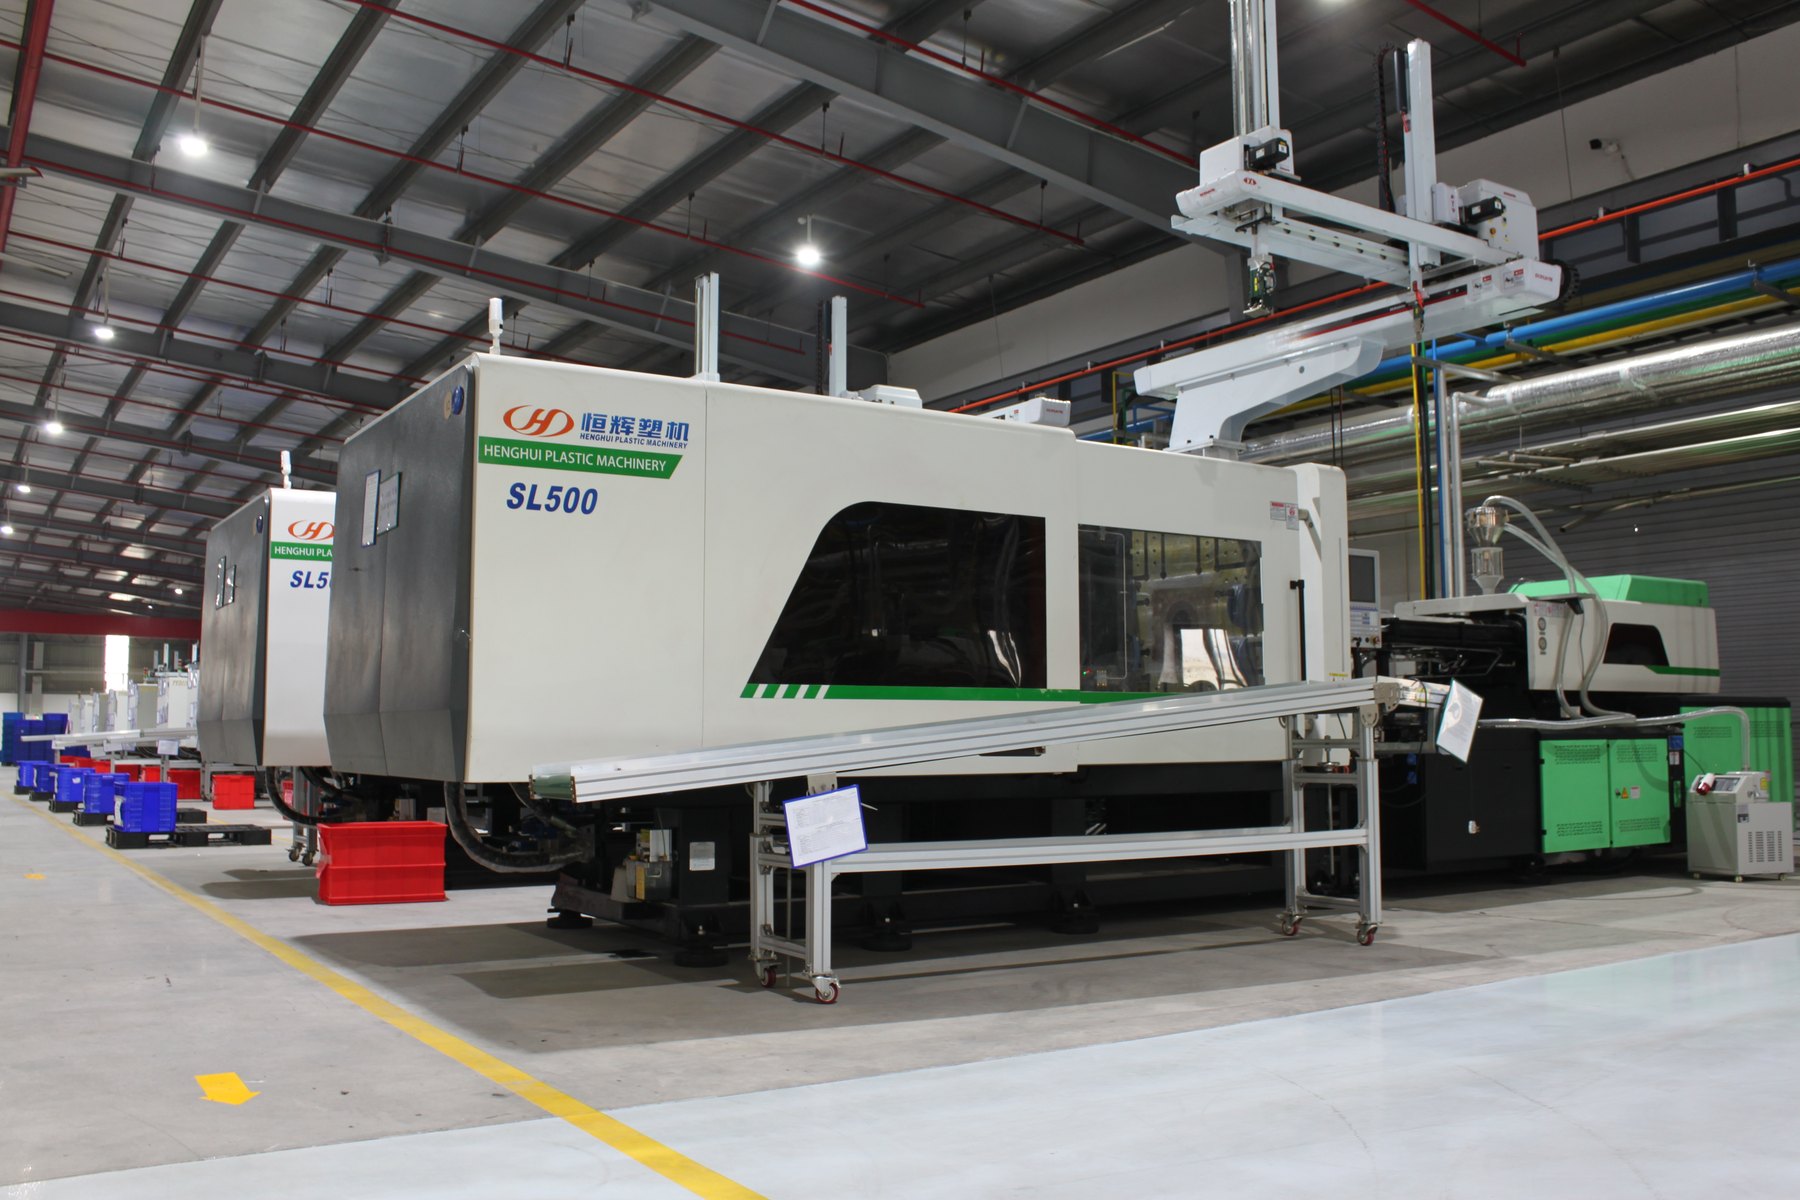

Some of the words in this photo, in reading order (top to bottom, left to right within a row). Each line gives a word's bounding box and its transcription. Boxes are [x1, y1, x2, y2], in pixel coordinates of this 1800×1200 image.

[580, 412, 690, 442] 恒辉塑机
[580, 433, 614, 443] HENGHUI
[615, 436, 645, 446] PLASTIC
[647, 439, 688, 450] MACHINERY
[484, 444, 542, 461] HENGHUI
[545, 450, 594, 466] PLASTIC
[596, 454, 667, 472] MACHINERY
[506, 482, 598, 515] SL500
[274, 546, 315, 557] HENGHUI
[290, 570, 331, 589] SL5
